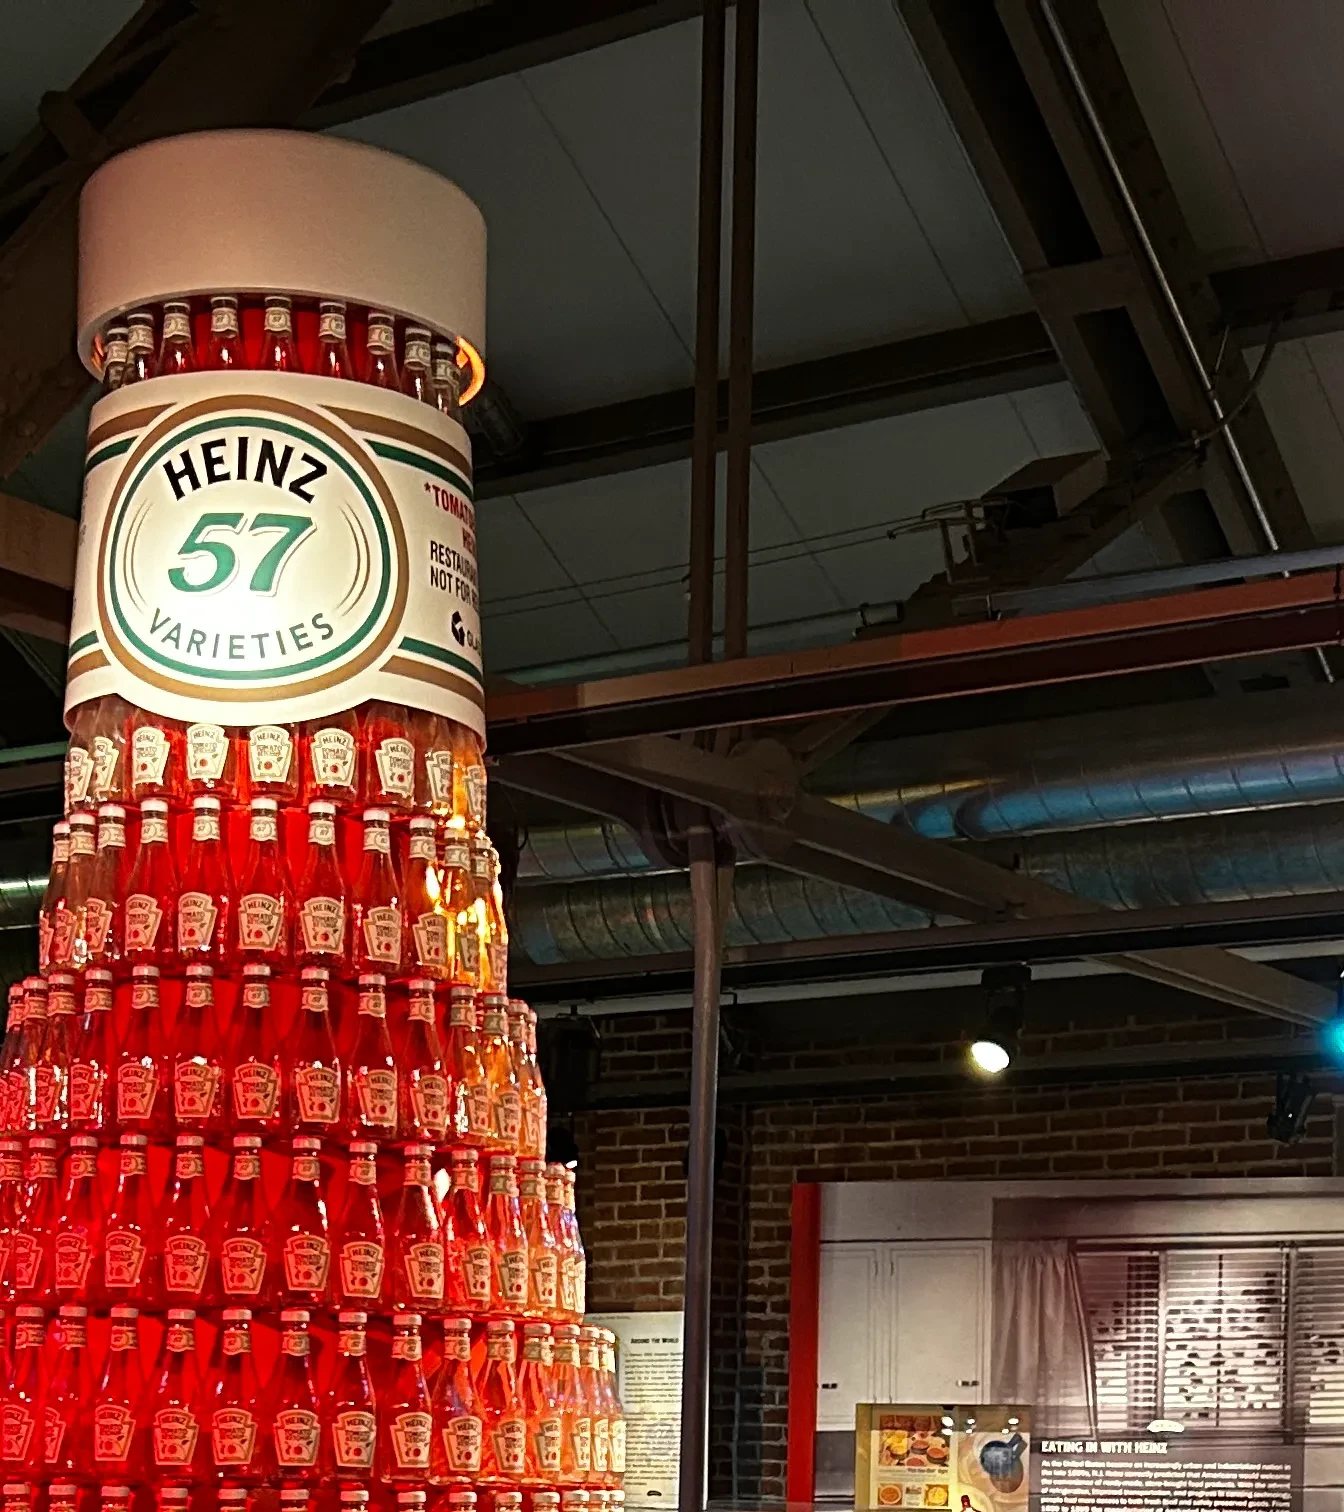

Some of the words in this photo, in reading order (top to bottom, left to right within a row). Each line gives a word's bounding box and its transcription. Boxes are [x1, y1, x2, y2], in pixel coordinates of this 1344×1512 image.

[163, 436, 328, 504] HEINZ
[167, 512, 318, 598] 57
[430, 565, 453, 594] NOT
[148, 608, 335, 661] VARIETIES
[257, 732, 281, 741] HEINZ
[322, 735, 347, 746] HEINZ
[312, 903, 337, 914] HEINZ
[1041, 1441, 1083, 1453] EATING
[1100, 1441, 1132, 1453] WITH
[1135, 1441, 1168, 1454] HEINZ
